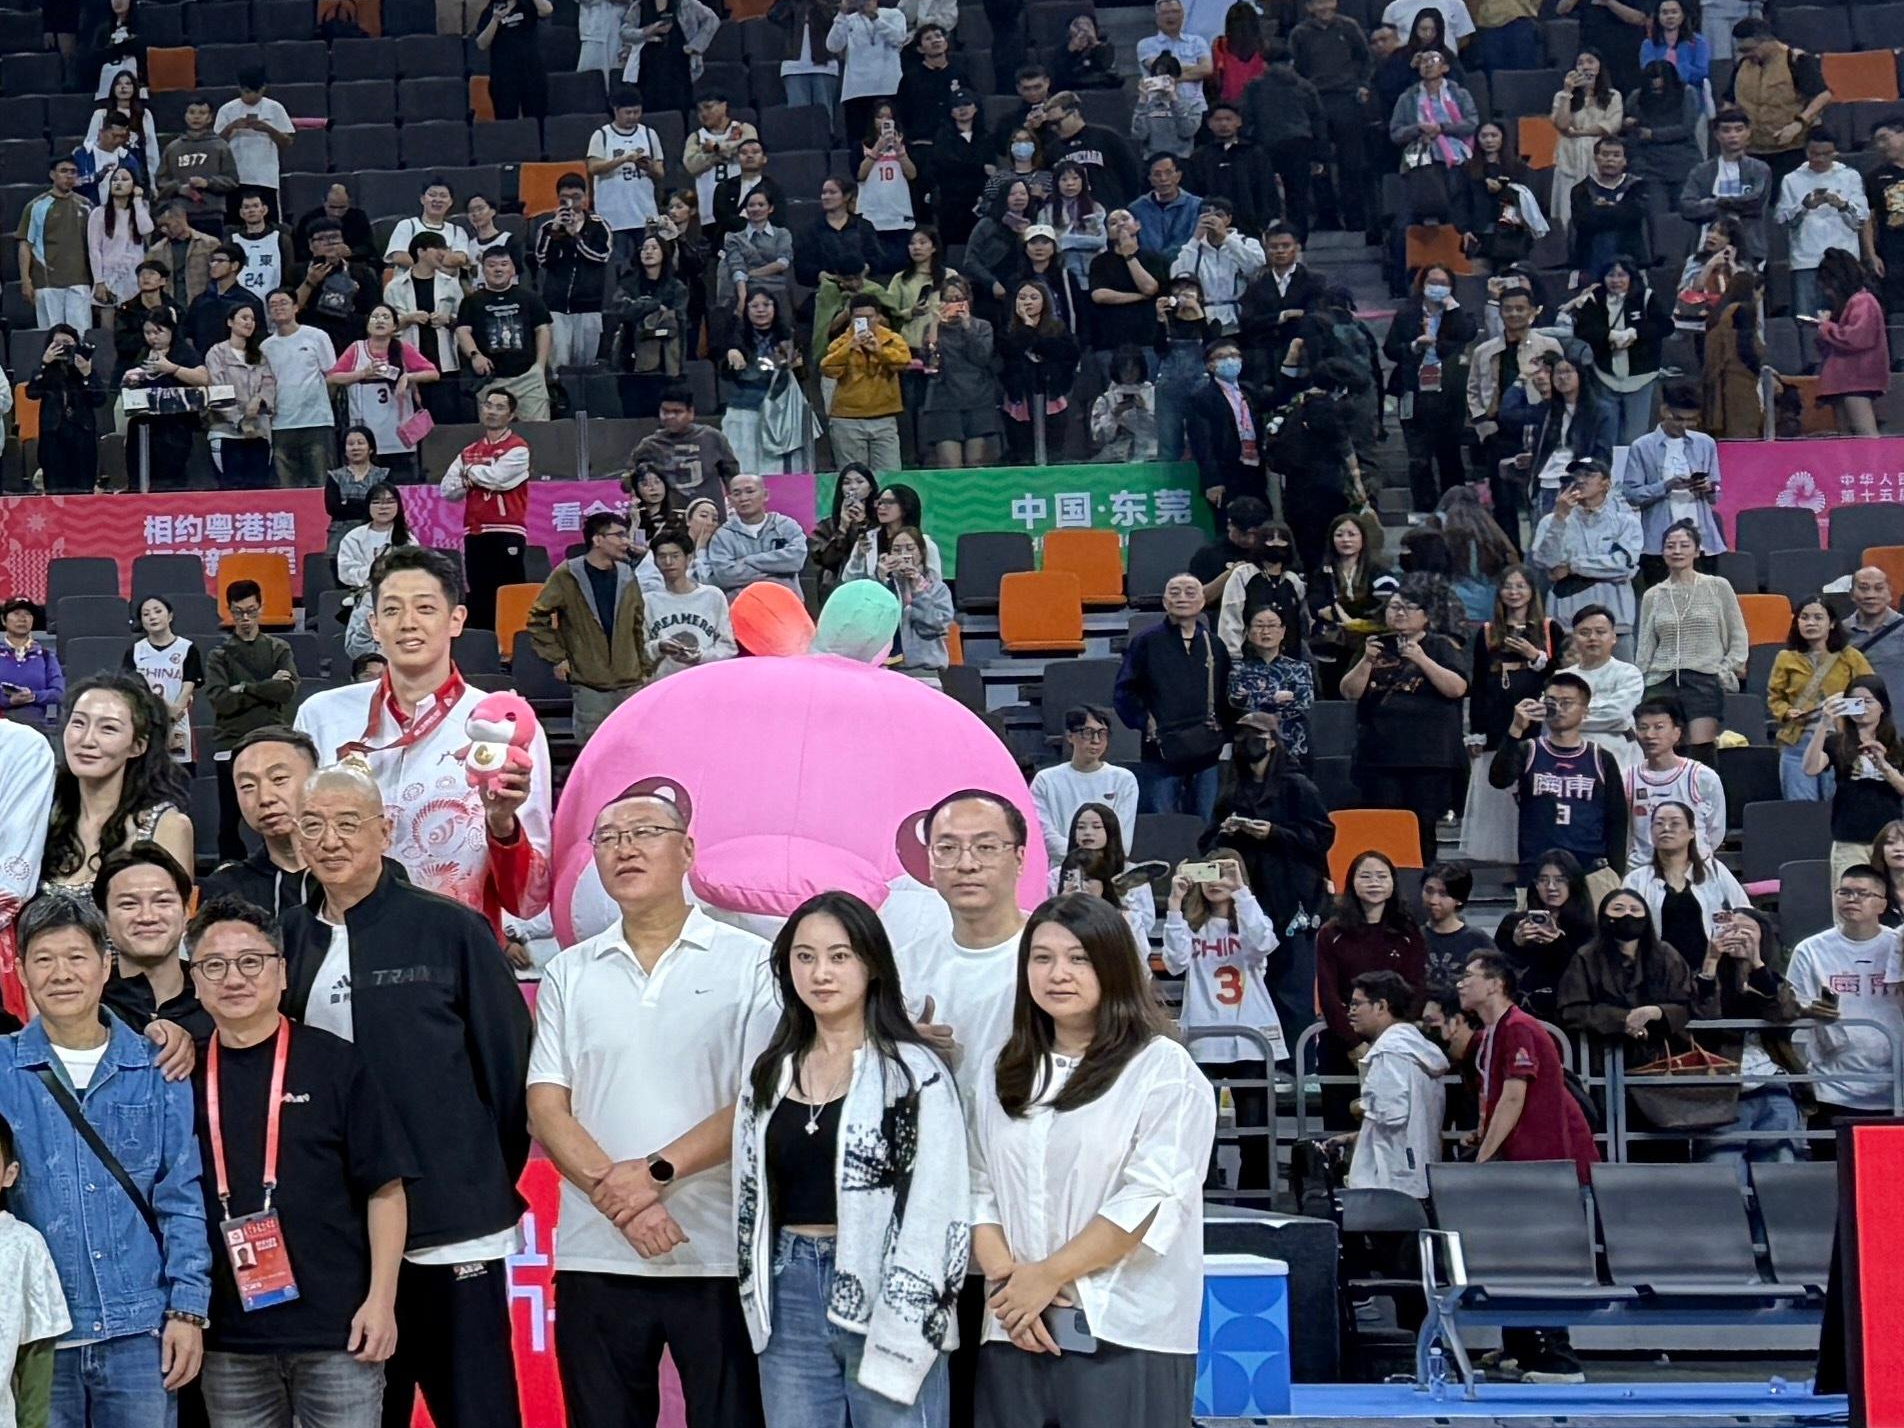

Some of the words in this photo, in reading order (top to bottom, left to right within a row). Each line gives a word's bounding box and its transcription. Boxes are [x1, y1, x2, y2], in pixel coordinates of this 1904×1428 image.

[244, 273, 265, 289] 24
[1012, 489, 1193, 529] 中国·东莞
[144, 512, 296, 545] 相约粤港澳
[1212, 964, 1245, 1006] 3
